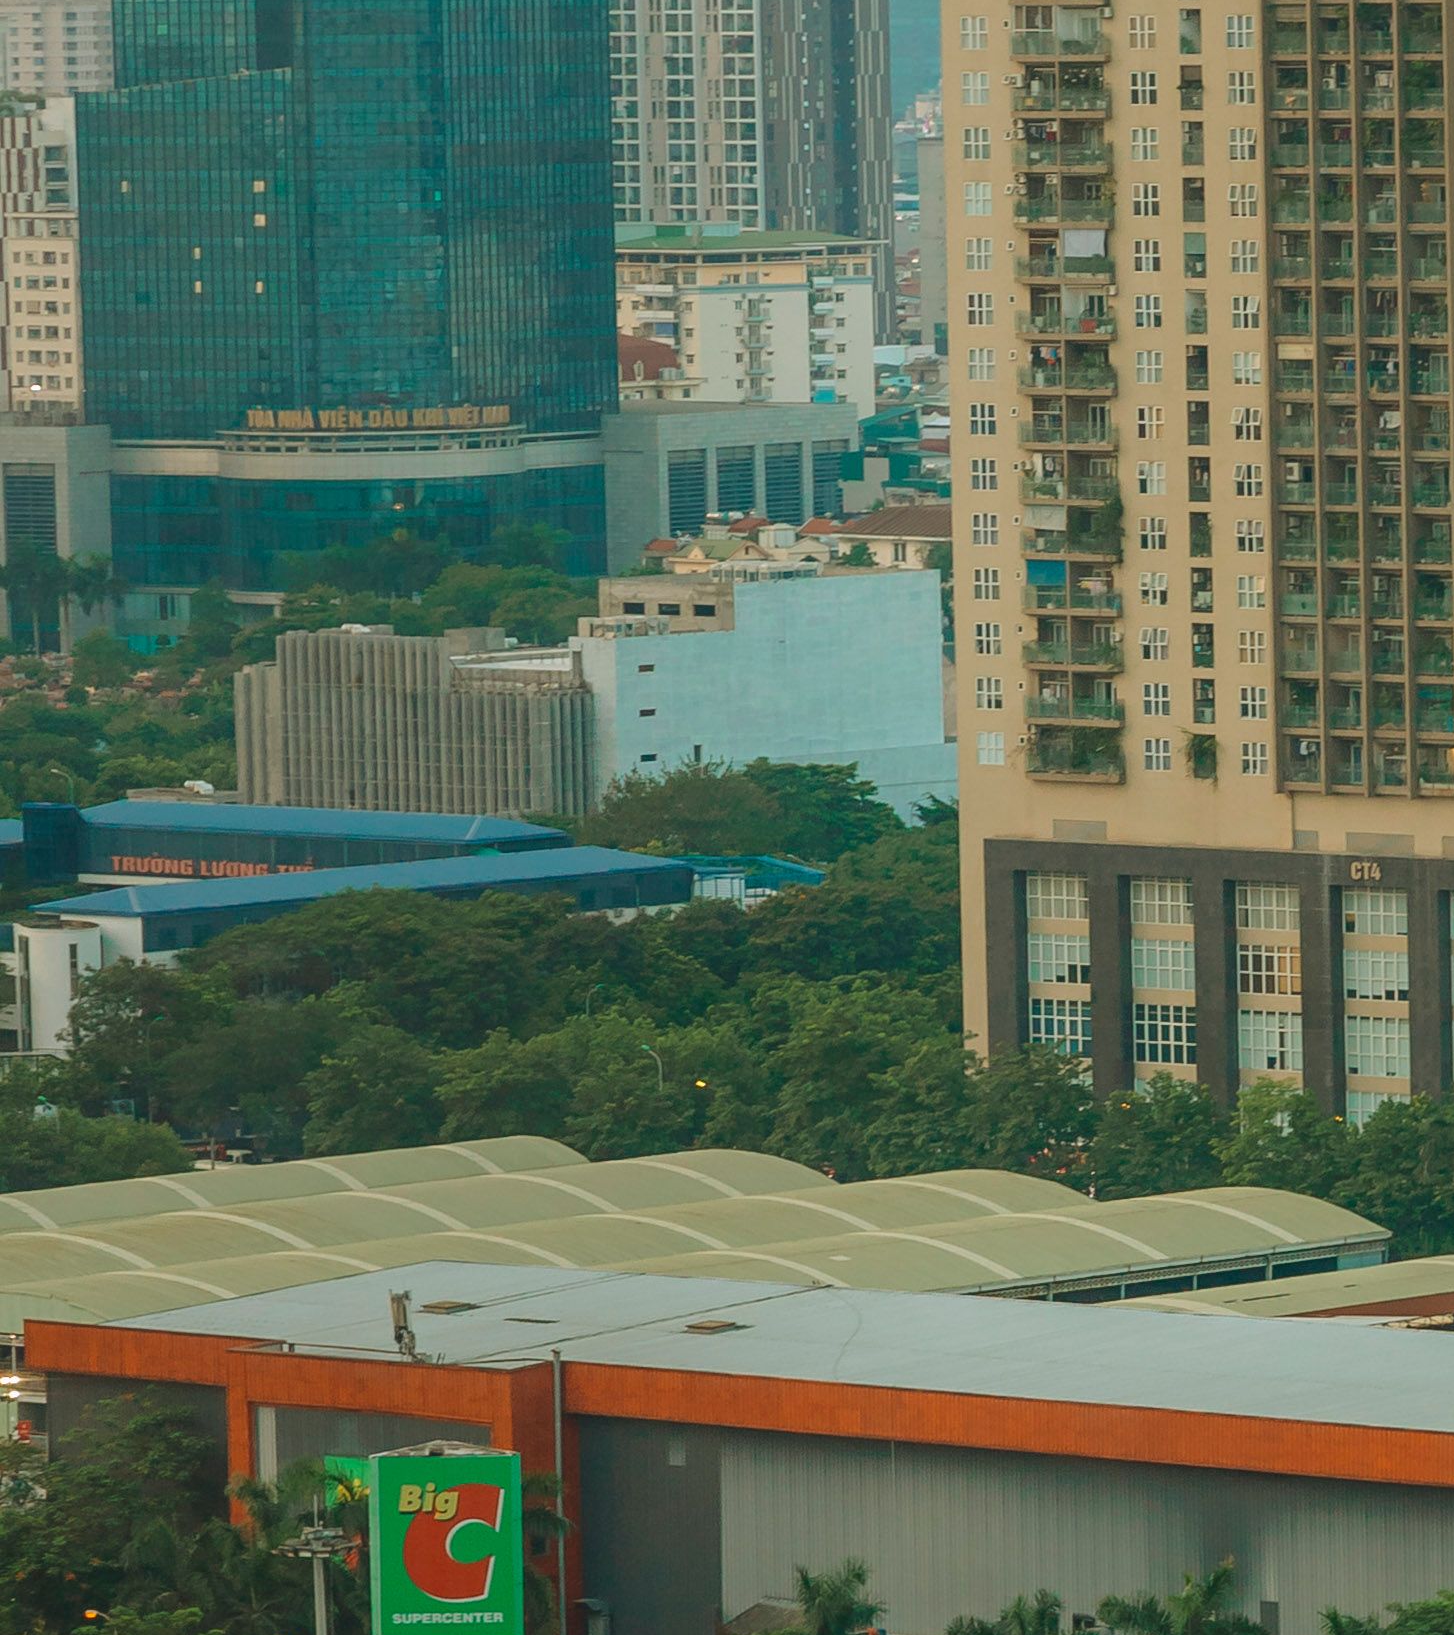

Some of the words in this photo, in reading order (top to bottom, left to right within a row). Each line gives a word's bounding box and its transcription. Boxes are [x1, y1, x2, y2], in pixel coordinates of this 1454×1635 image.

[111, 852, 193, 875] TRƯỜNG
[1350, 861, 1381, 881] CT4
[398, 1482, 460, 1521] Big
[402, 1482, 505, 1603] C
[392, 1612, 505, 1624] SUPERCENTER
